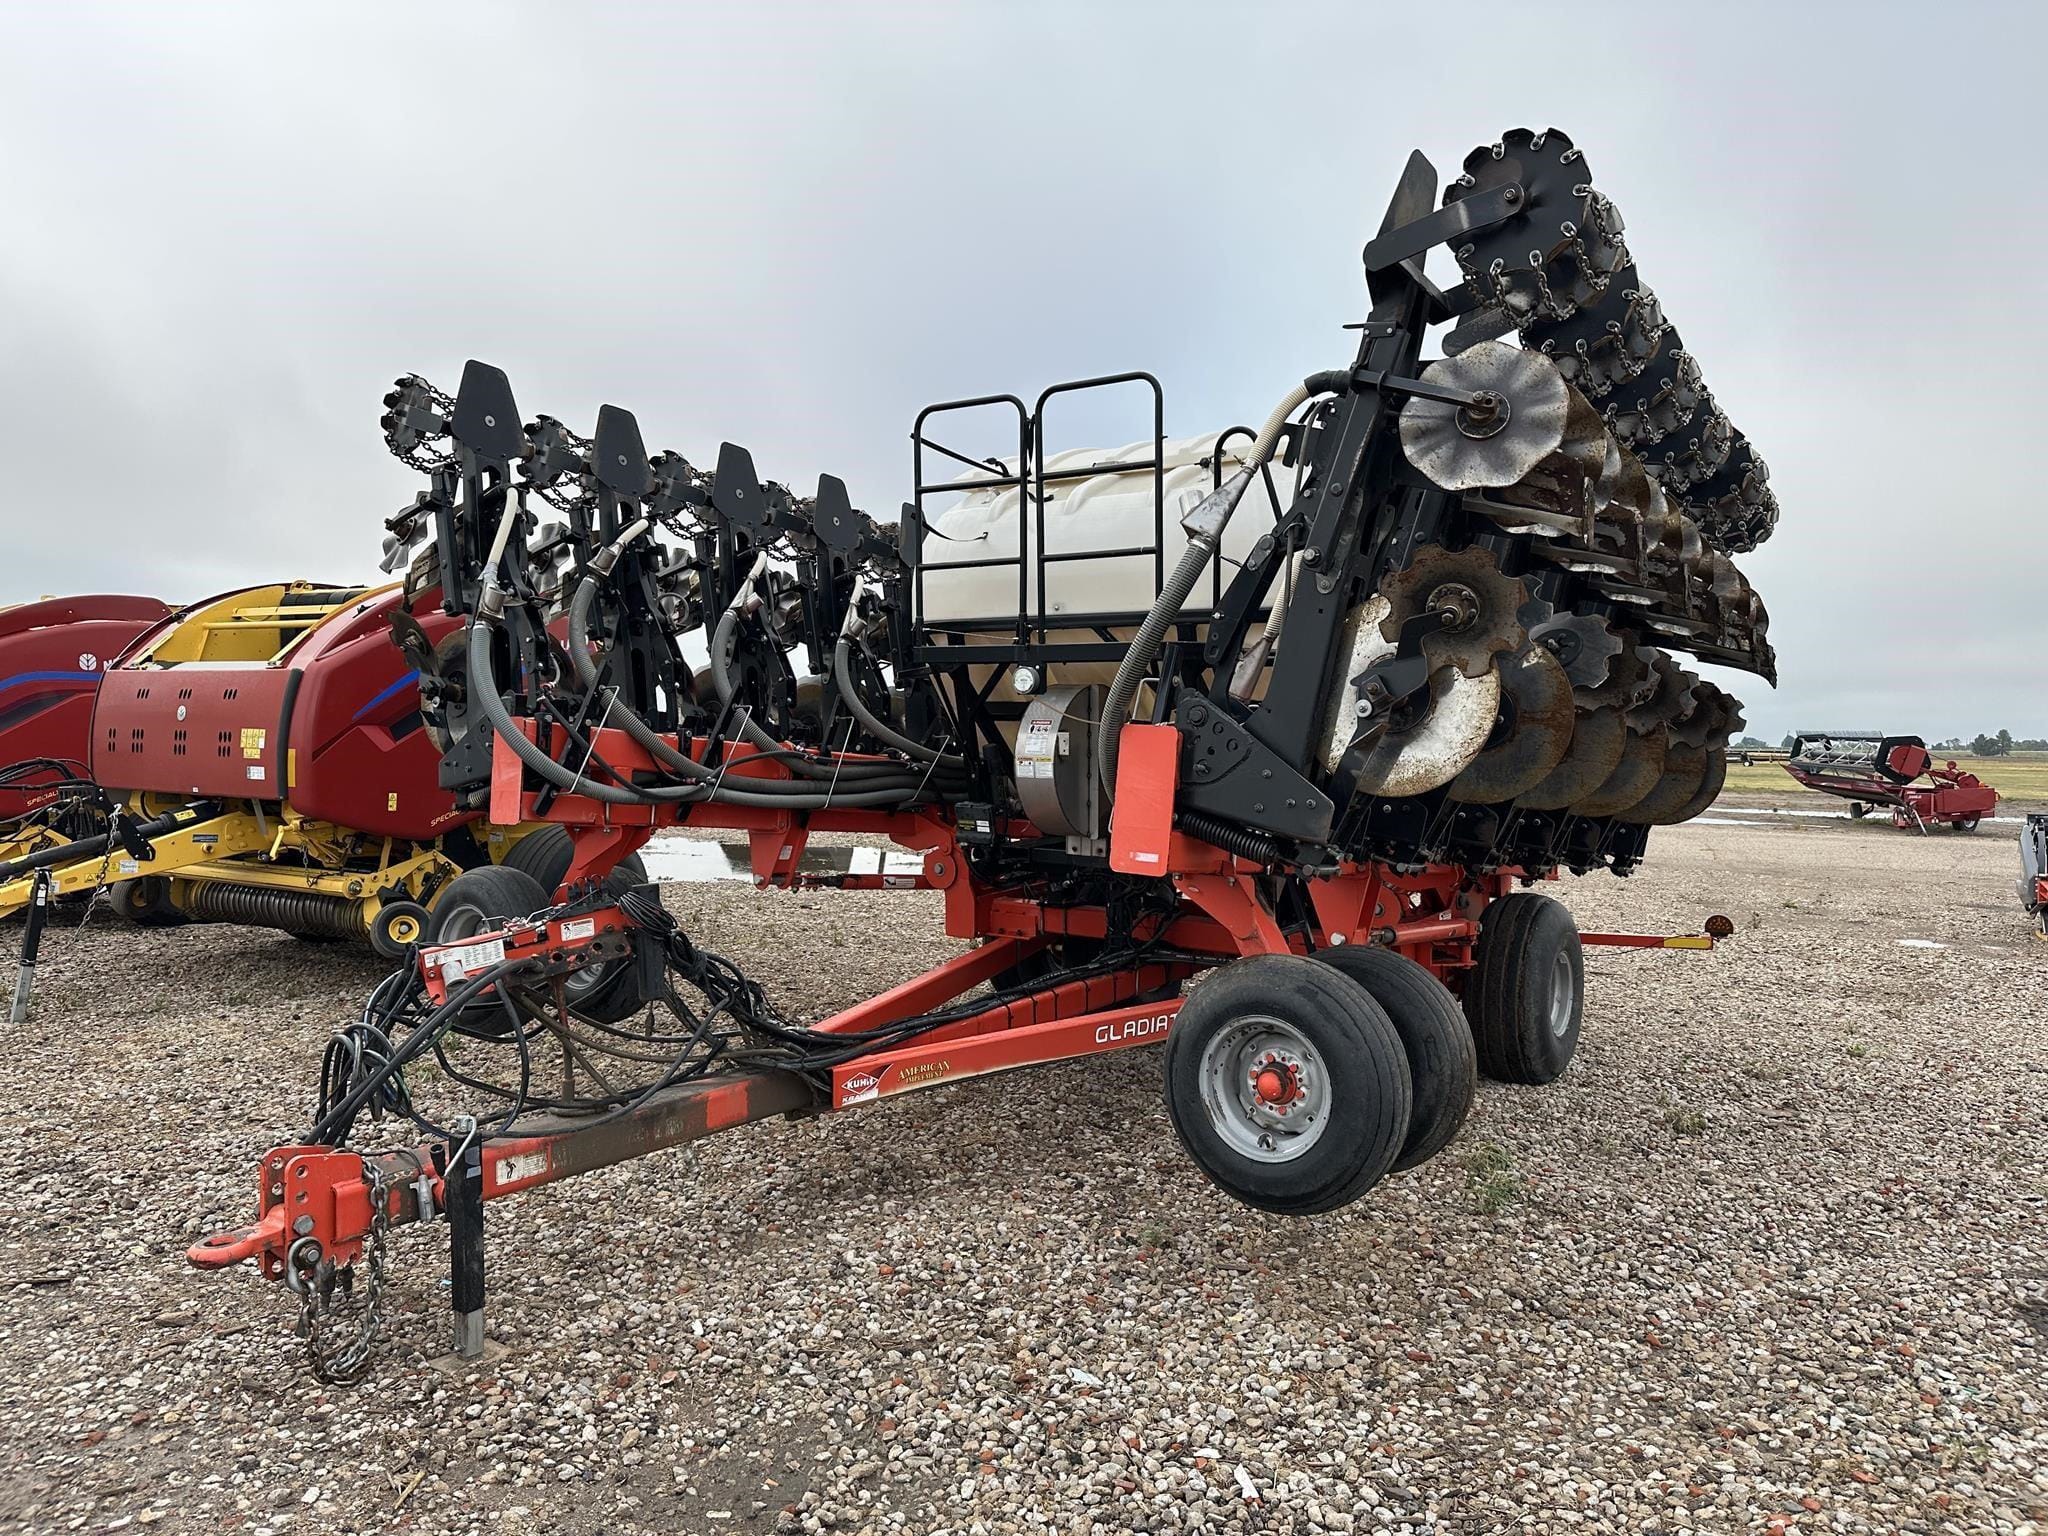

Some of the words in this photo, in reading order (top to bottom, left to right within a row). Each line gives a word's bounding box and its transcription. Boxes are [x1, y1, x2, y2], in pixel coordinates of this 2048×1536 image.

[430, 809, 461, 827] SPECIAL
[898, 1060, 950, 1079] AMERICAN
[847, 1077, 873, 1089] KUHN
